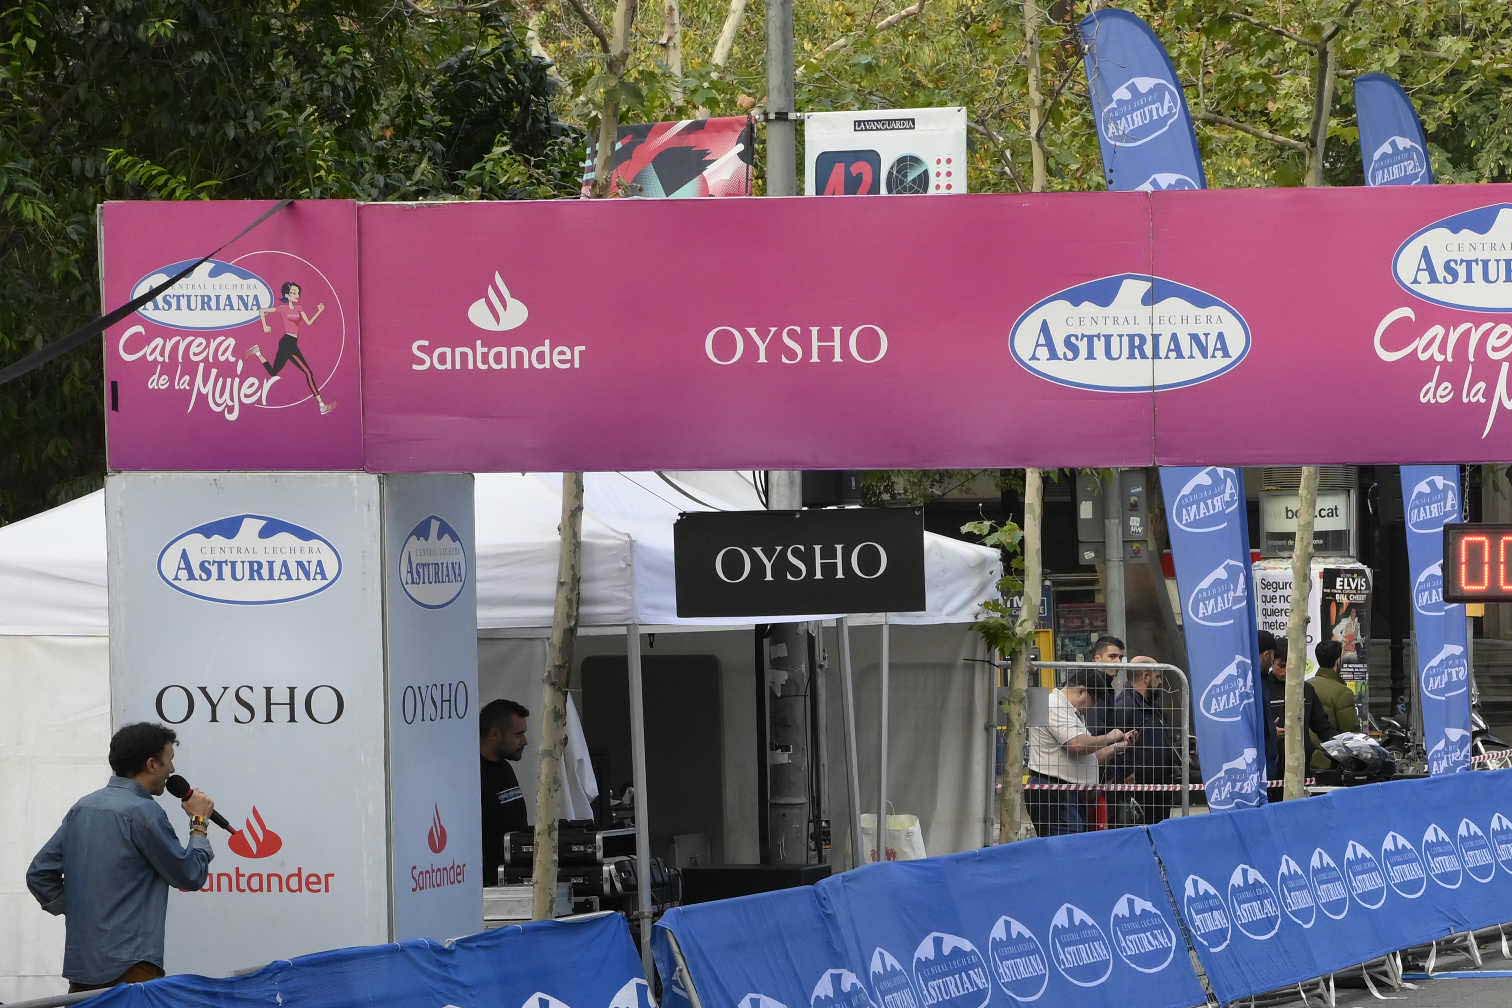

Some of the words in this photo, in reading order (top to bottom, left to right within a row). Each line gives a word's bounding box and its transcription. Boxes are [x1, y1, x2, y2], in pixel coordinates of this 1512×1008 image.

[142, 285, 262, 312] ASTURIANA
[168, 282, 208, 291] ENTRAL
[1065, 315, 1140, 328] CENTRAL
[1147, 313, 1224, 326] LECHERA
[118, 324, 238, 362] Carrera
[411, 338, 587, 371] Santander
[704, 324, 889, 365] OYSHO
[1028, 318, 1233, 362] ASTURIANA
[147, 365, 170, 390] de
[174, 366, 191, 390] la
[187, 359, 281, 422] Mujer
[1418, 364, 1454, 404] de
[1462, 361, 1487, 404] la
[172, 547, 329, 582] ASTURIANA
[200, 545, 258, 555] CENTRAL
[263, 545, 322, 555] LECHERA
[715, 541, 888, 583] OYSHO
[404, 559, 464, 586] ASTURIANA
[1335, 577, 1367, 590] ELVIS
[1261, 594, 1278, 606] que
[155, 683, 345, 725] OYSHO
[402, 680, 469, 725] OYSHO
[179, 866, 335, 894] antander
[410, 859, 466, 893] Santander
[917, 967, 988, 1007] ASTURIANA
